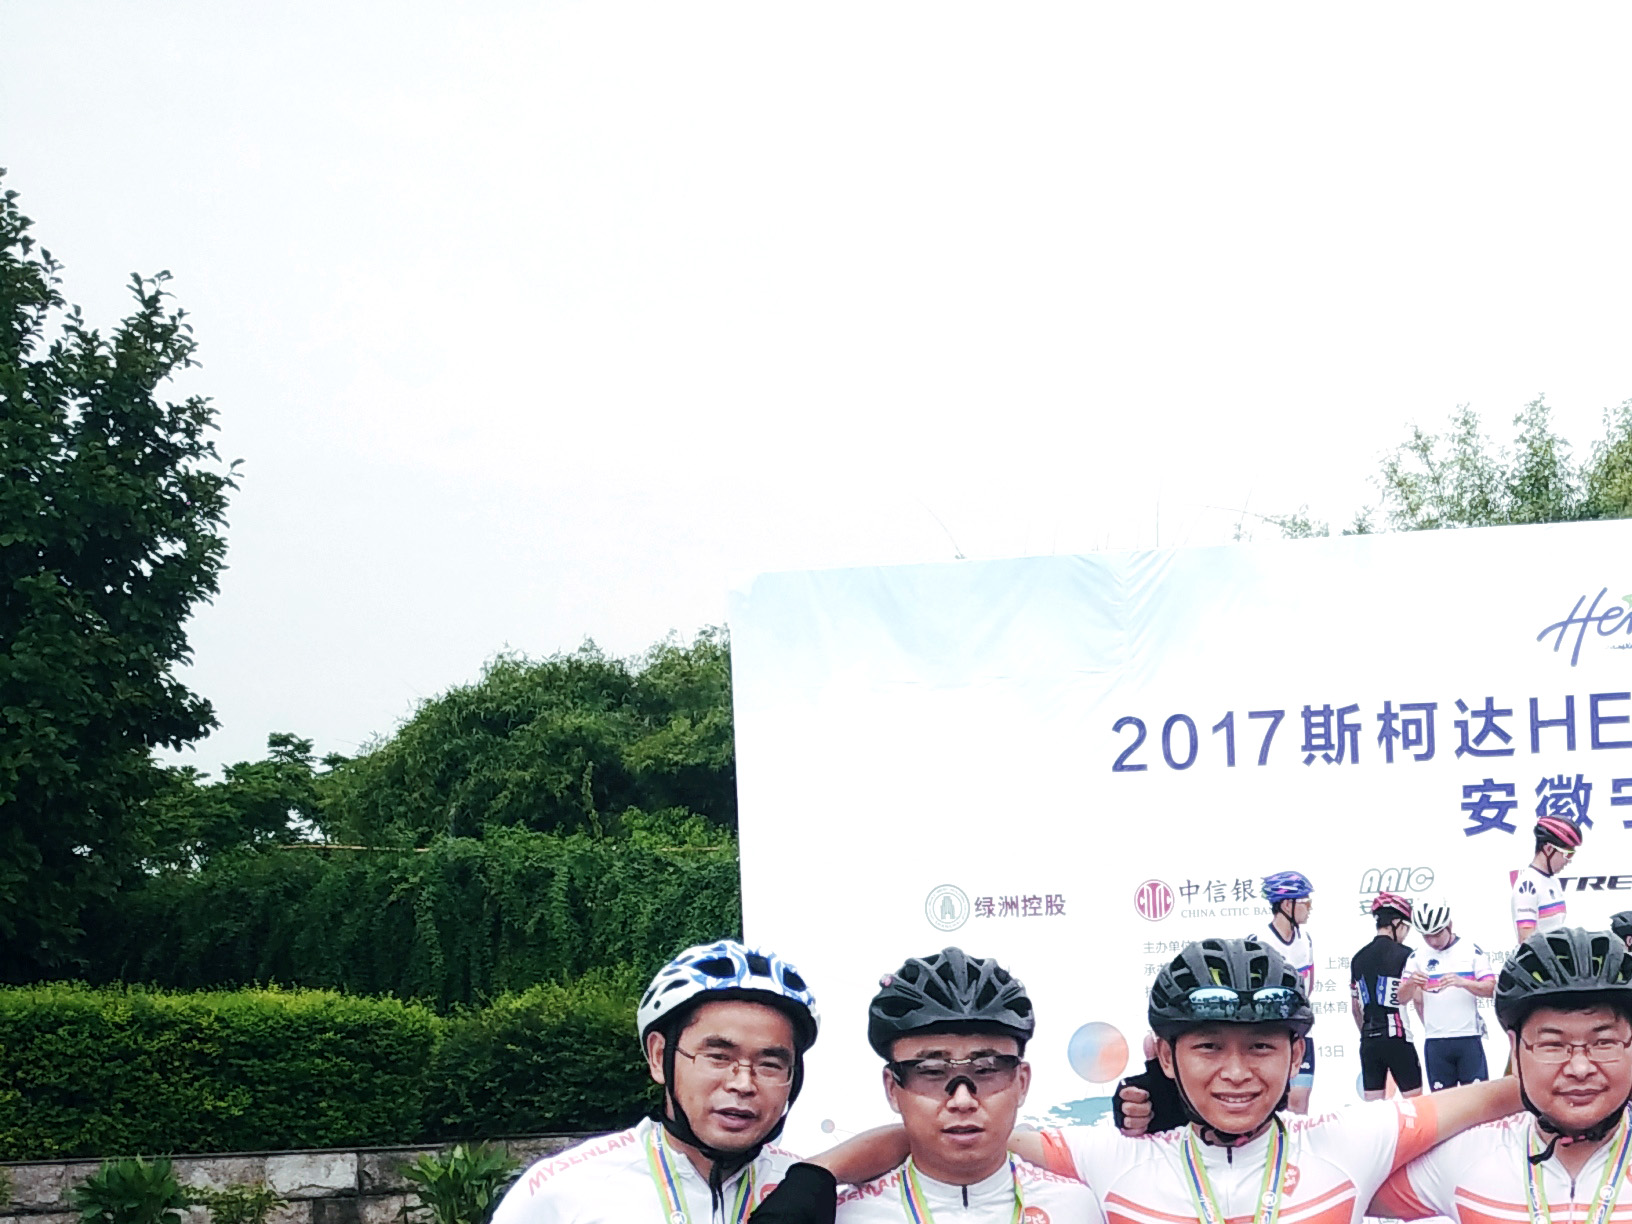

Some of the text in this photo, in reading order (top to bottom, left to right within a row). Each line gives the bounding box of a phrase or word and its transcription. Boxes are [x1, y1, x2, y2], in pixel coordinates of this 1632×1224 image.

[1179, 877, 1266, 904] 中信银
[974, 894, 1067, 919] 绿洲控股
[1181, 906, 1276, 918] CHINA CITIC BAN
[527, 1130, 637, 1197] MYSENLAN
